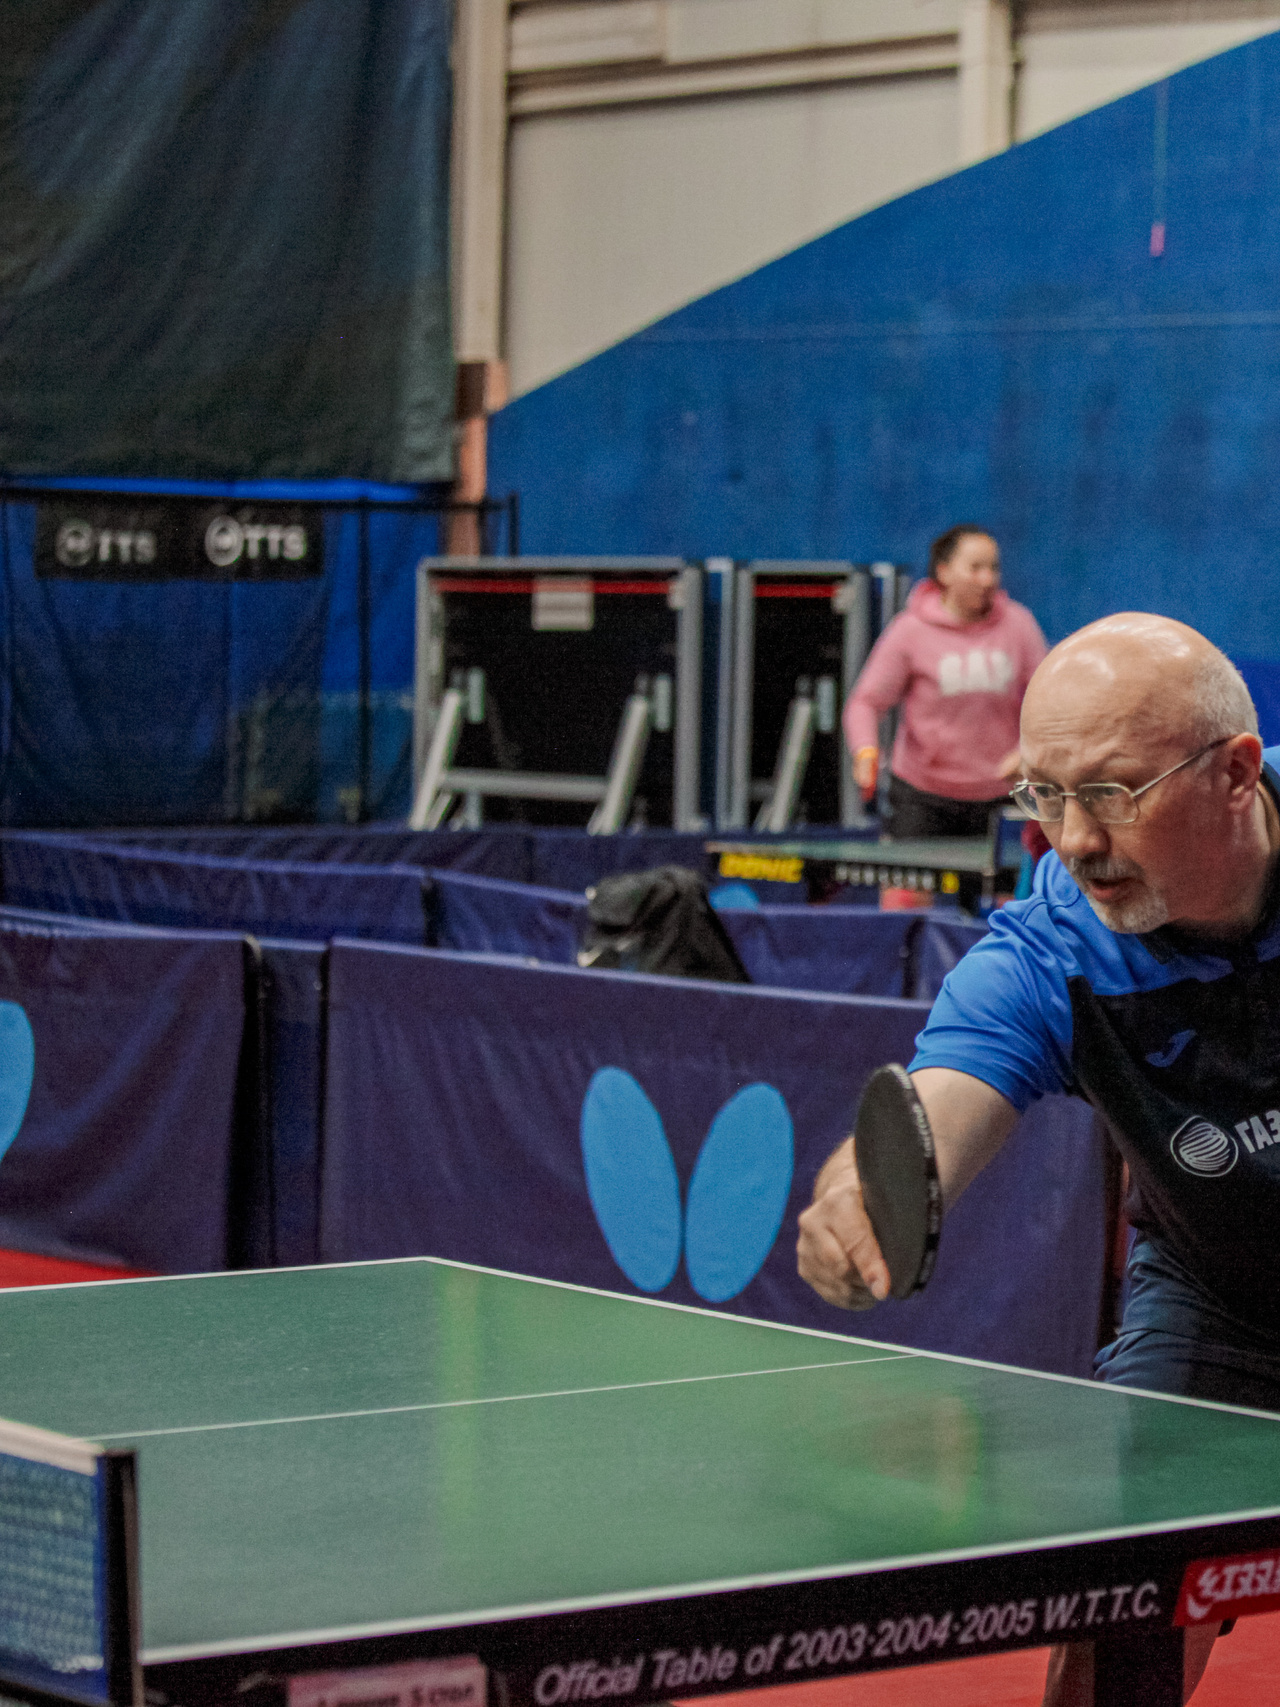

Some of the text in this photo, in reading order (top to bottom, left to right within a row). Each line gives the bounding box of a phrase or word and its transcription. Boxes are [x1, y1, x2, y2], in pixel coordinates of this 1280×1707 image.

[534, 1655, 646, 1706] Official
[649, 1645, 738, 1691] Table
[744, 1634, 782, 1676] of
[1043, 1579, 1162, 1632] W.T.T.C.
